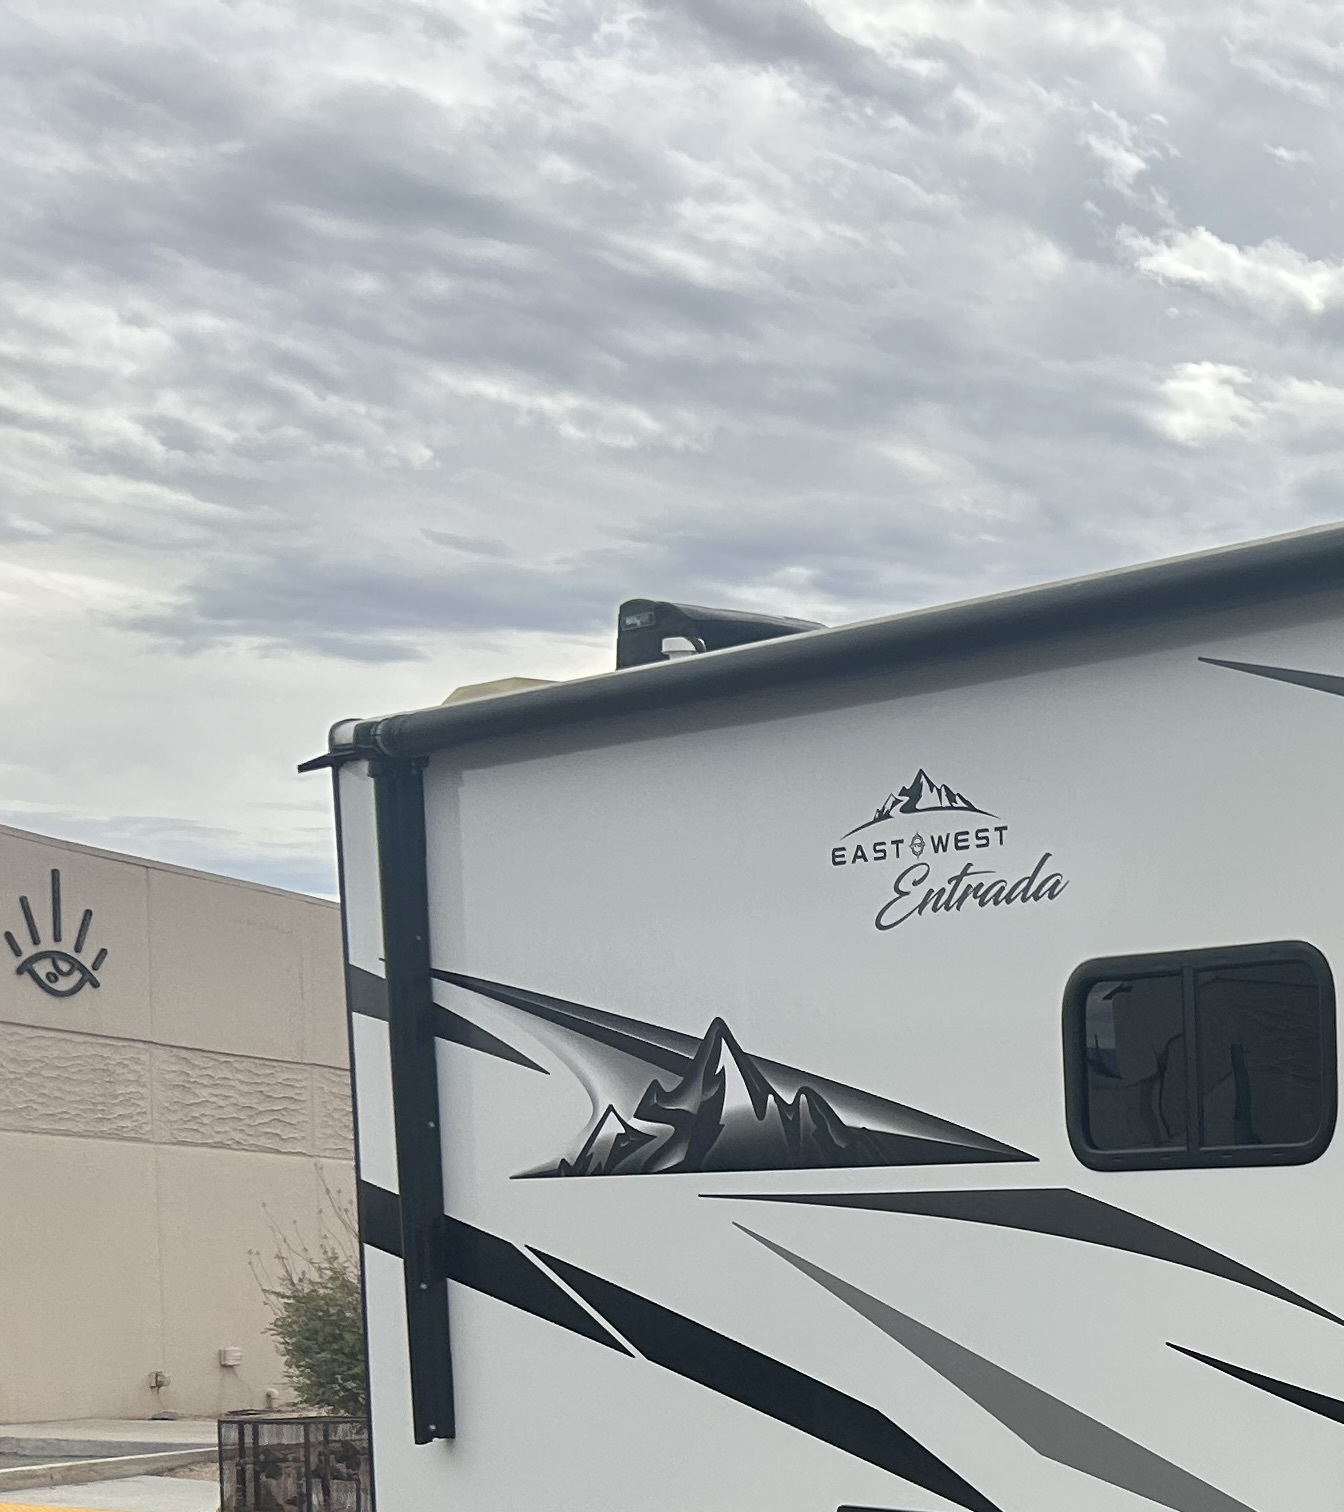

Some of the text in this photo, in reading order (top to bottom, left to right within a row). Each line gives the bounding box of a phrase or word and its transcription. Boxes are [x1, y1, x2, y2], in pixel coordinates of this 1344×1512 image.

[831, 825, 1009, 866] EAST WEST
[874, 852, 1070, 931] Entrada
